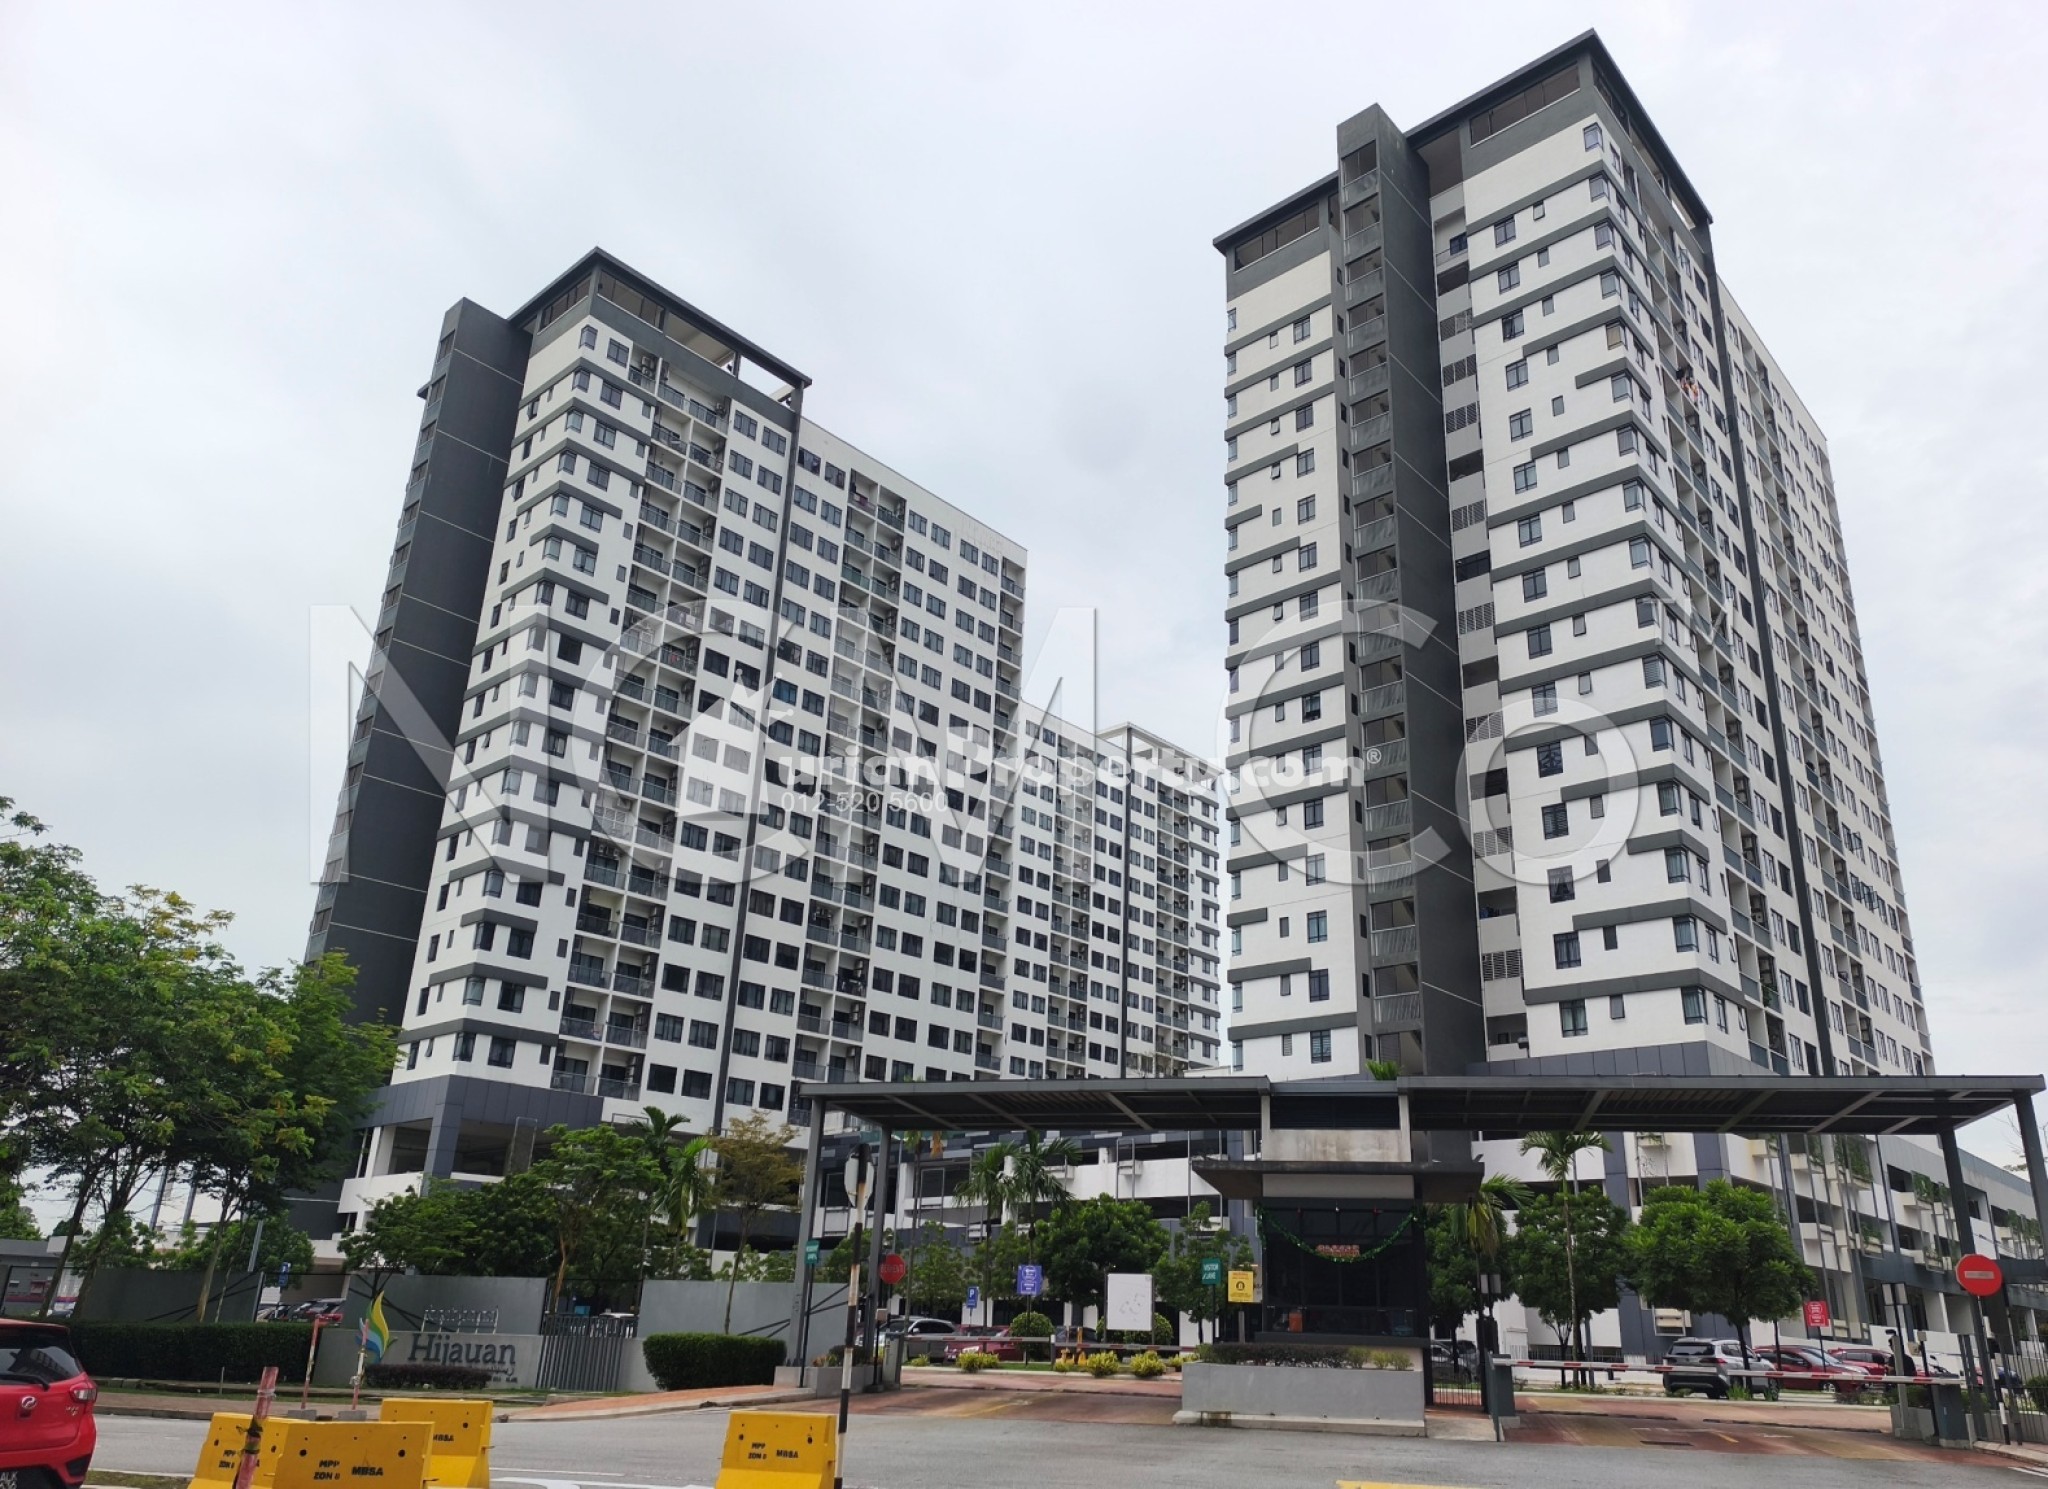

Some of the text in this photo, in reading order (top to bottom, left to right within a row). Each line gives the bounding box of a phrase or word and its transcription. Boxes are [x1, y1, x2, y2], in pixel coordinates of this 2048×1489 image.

[407, 1332, 516, 1366] Hijauan
[319, 1460, 340, 1468] MPP
[314, 1471, 333, 1480] ZON
[352, 1466, 384, 1476] MBSA
